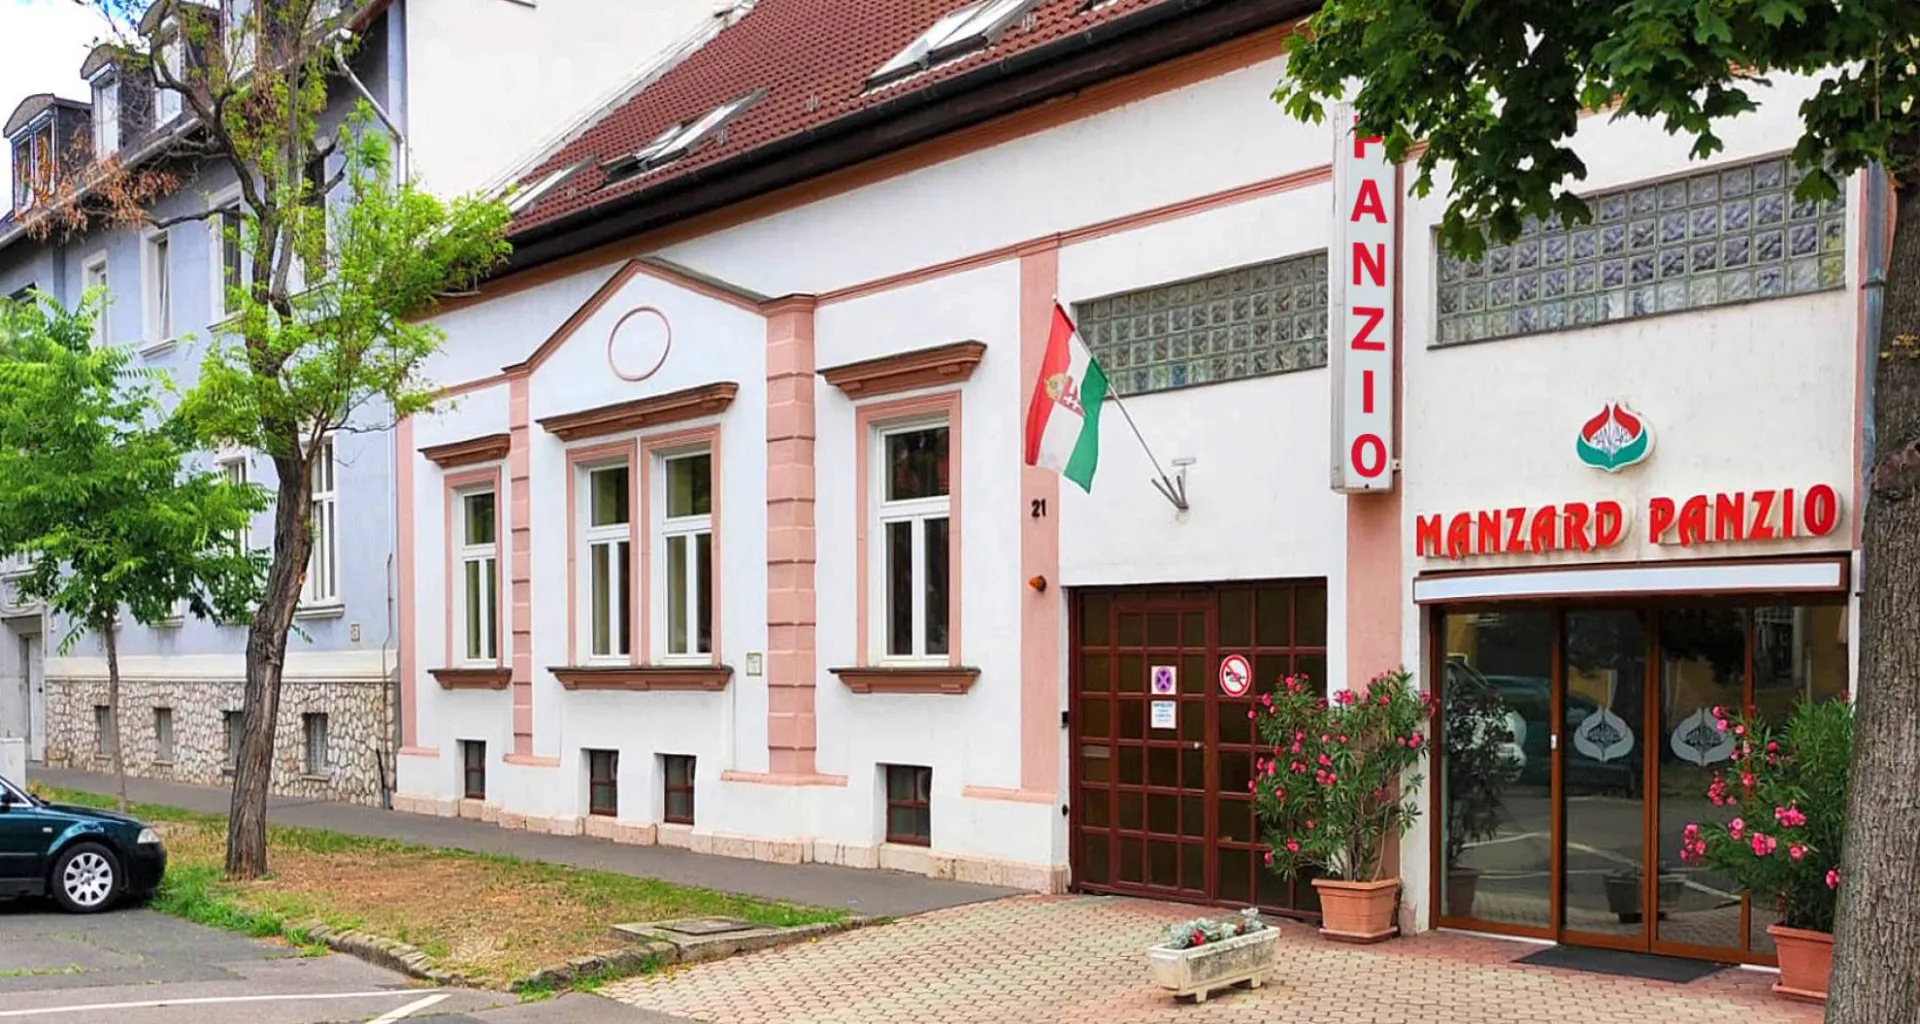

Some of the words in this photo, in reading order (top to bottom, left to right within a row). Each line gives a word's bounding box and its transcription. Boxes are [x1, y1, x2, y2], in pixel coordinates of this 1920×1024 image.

[1031, 498, 1046, 518] 21
[1416, 501, 1623, 561] MANZARD
[1649, 484, 1836, 548] PANZIO
